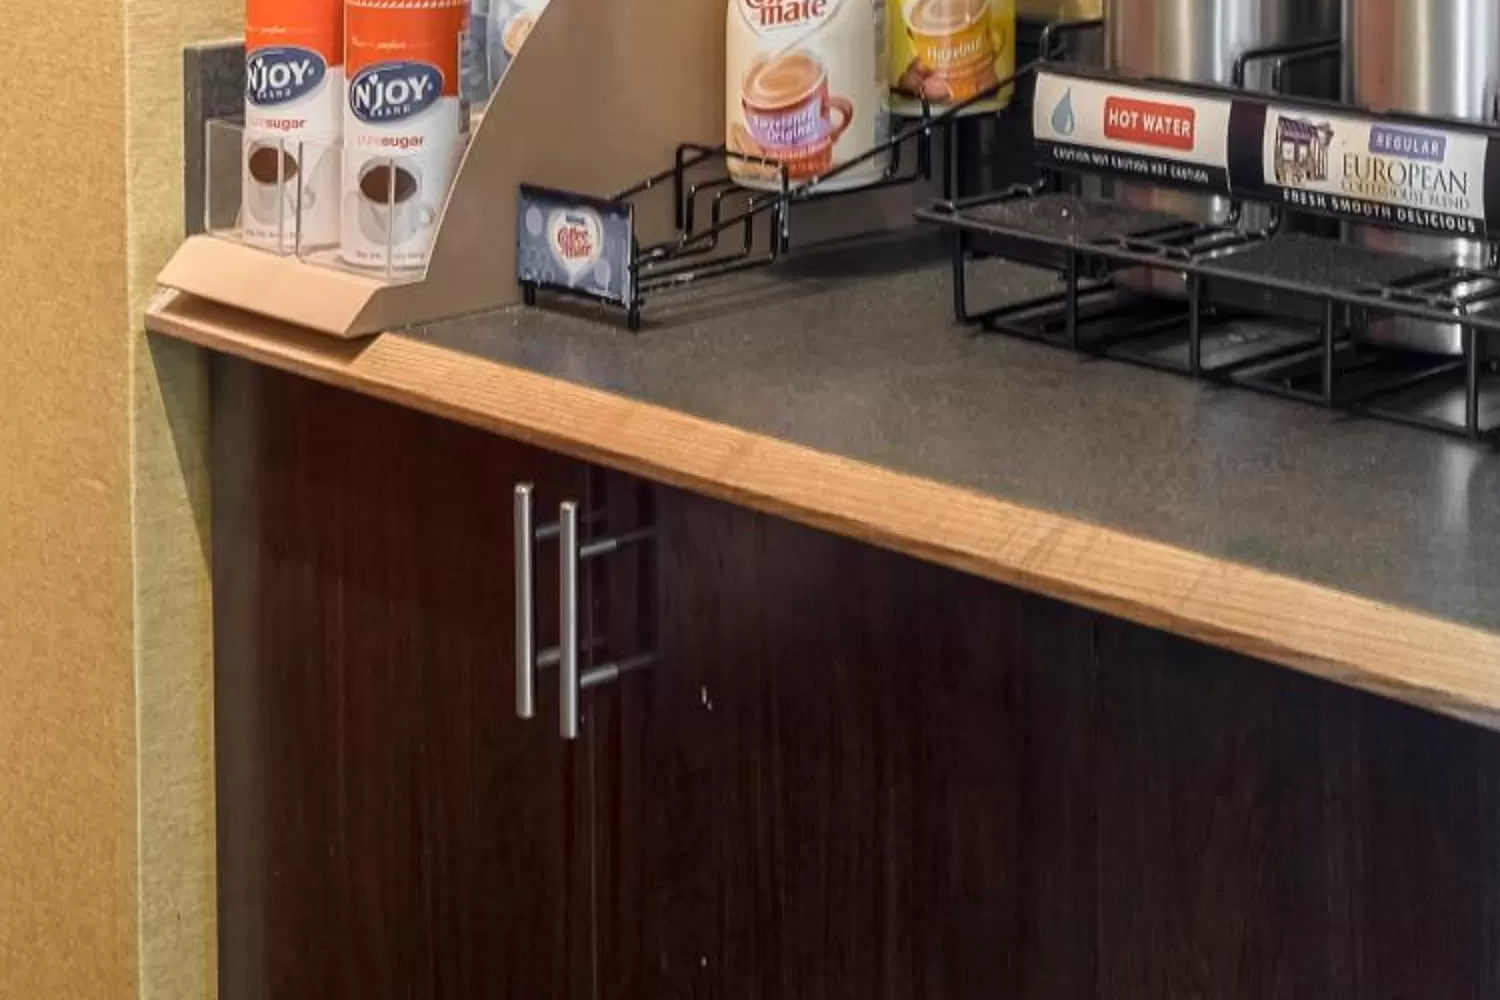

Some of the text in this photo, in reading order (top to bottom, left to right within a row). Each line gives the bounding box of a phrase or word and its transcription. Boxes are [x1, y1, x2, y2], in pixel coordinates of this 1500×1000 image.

[1108, 106, 1192, 139] HOT WATER
[1374, 132, 1440, 157] REGULAR
[1342, 151, 1470, 197] EUROPEAN
[1283, 187, 1476, 234] FRESH SMOOTH DELICIOUS
